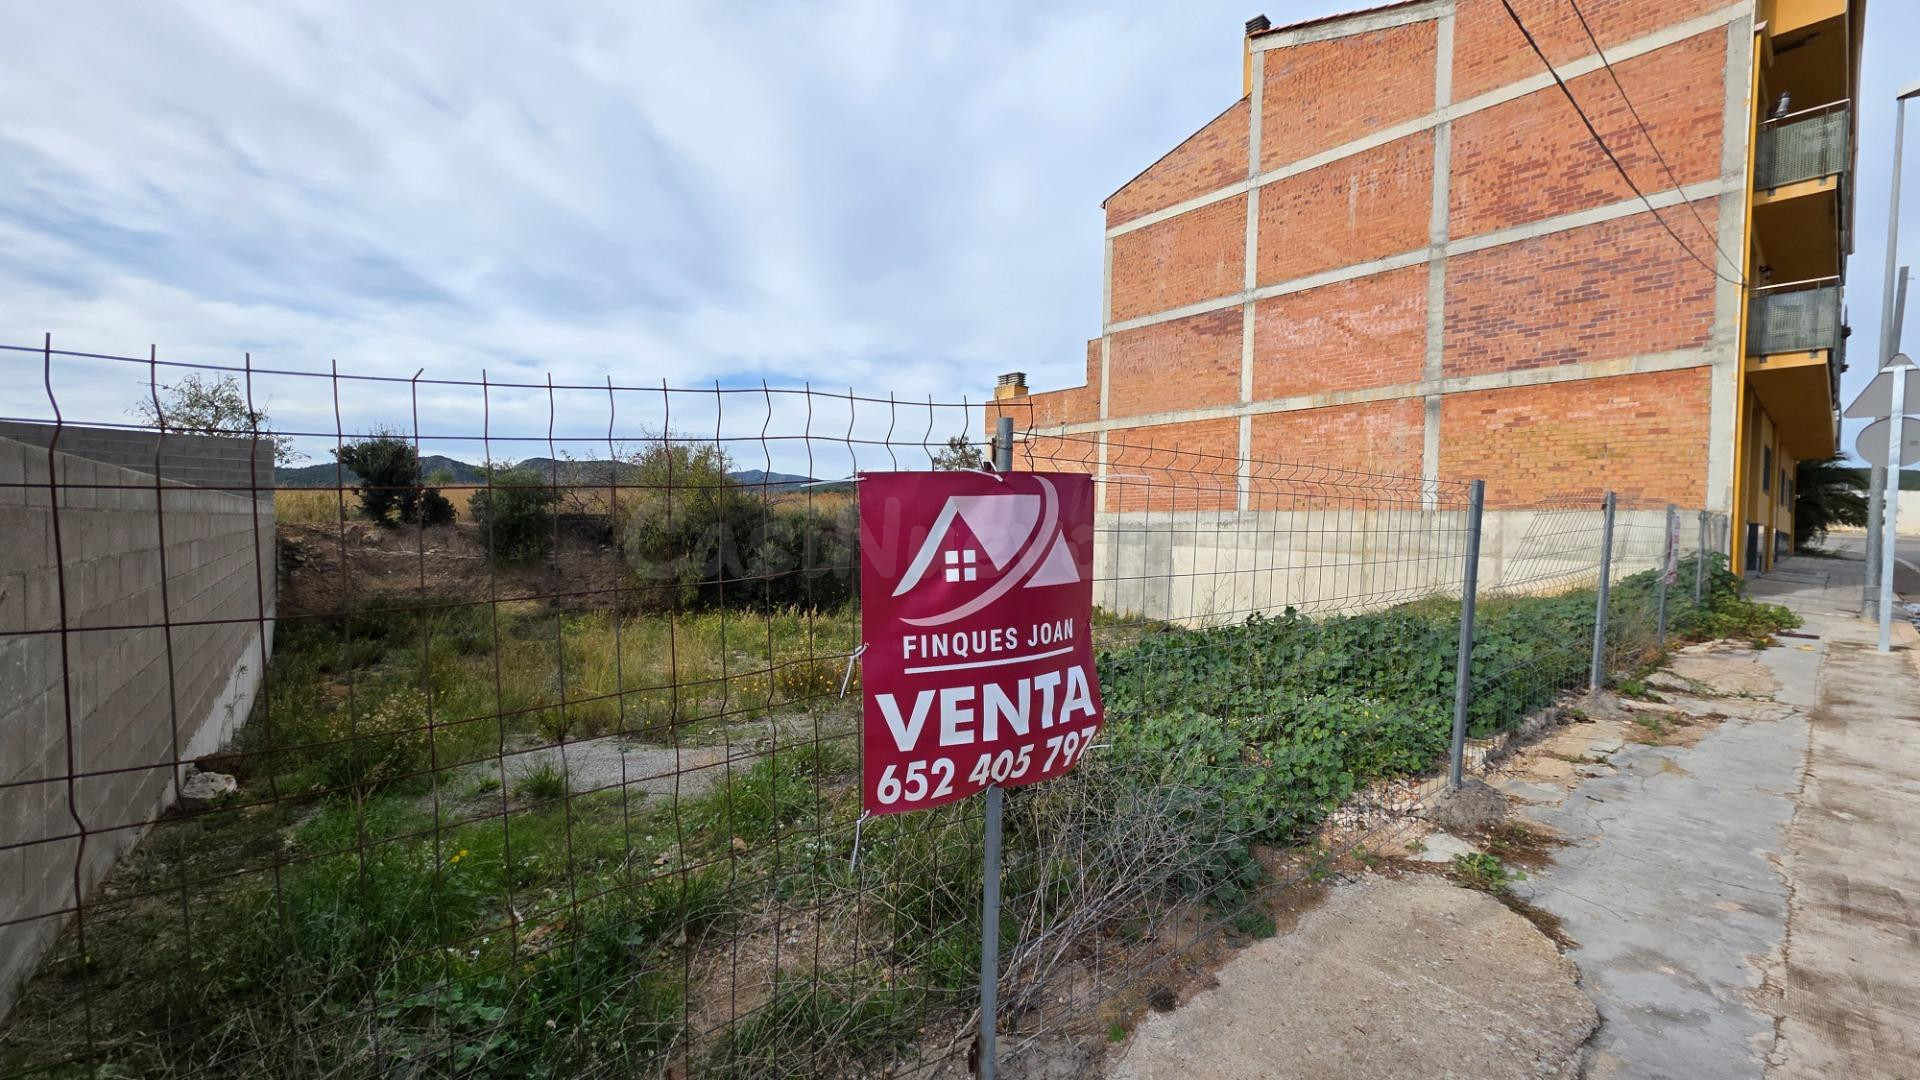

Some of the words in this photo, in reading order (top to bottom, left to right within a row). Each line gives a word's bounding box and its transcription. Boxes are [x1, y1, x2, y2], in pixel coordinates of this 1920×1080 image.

[903, 628, 1018, 660] FINQUES
[1027, 617, 1074, 647] JOAN
[875, 665, 1097, 752] VENTA
[876, 757, 956, 805] 652
[967, 743, 1035, 785] 405
[1042, 725, 1097, 773] 797
